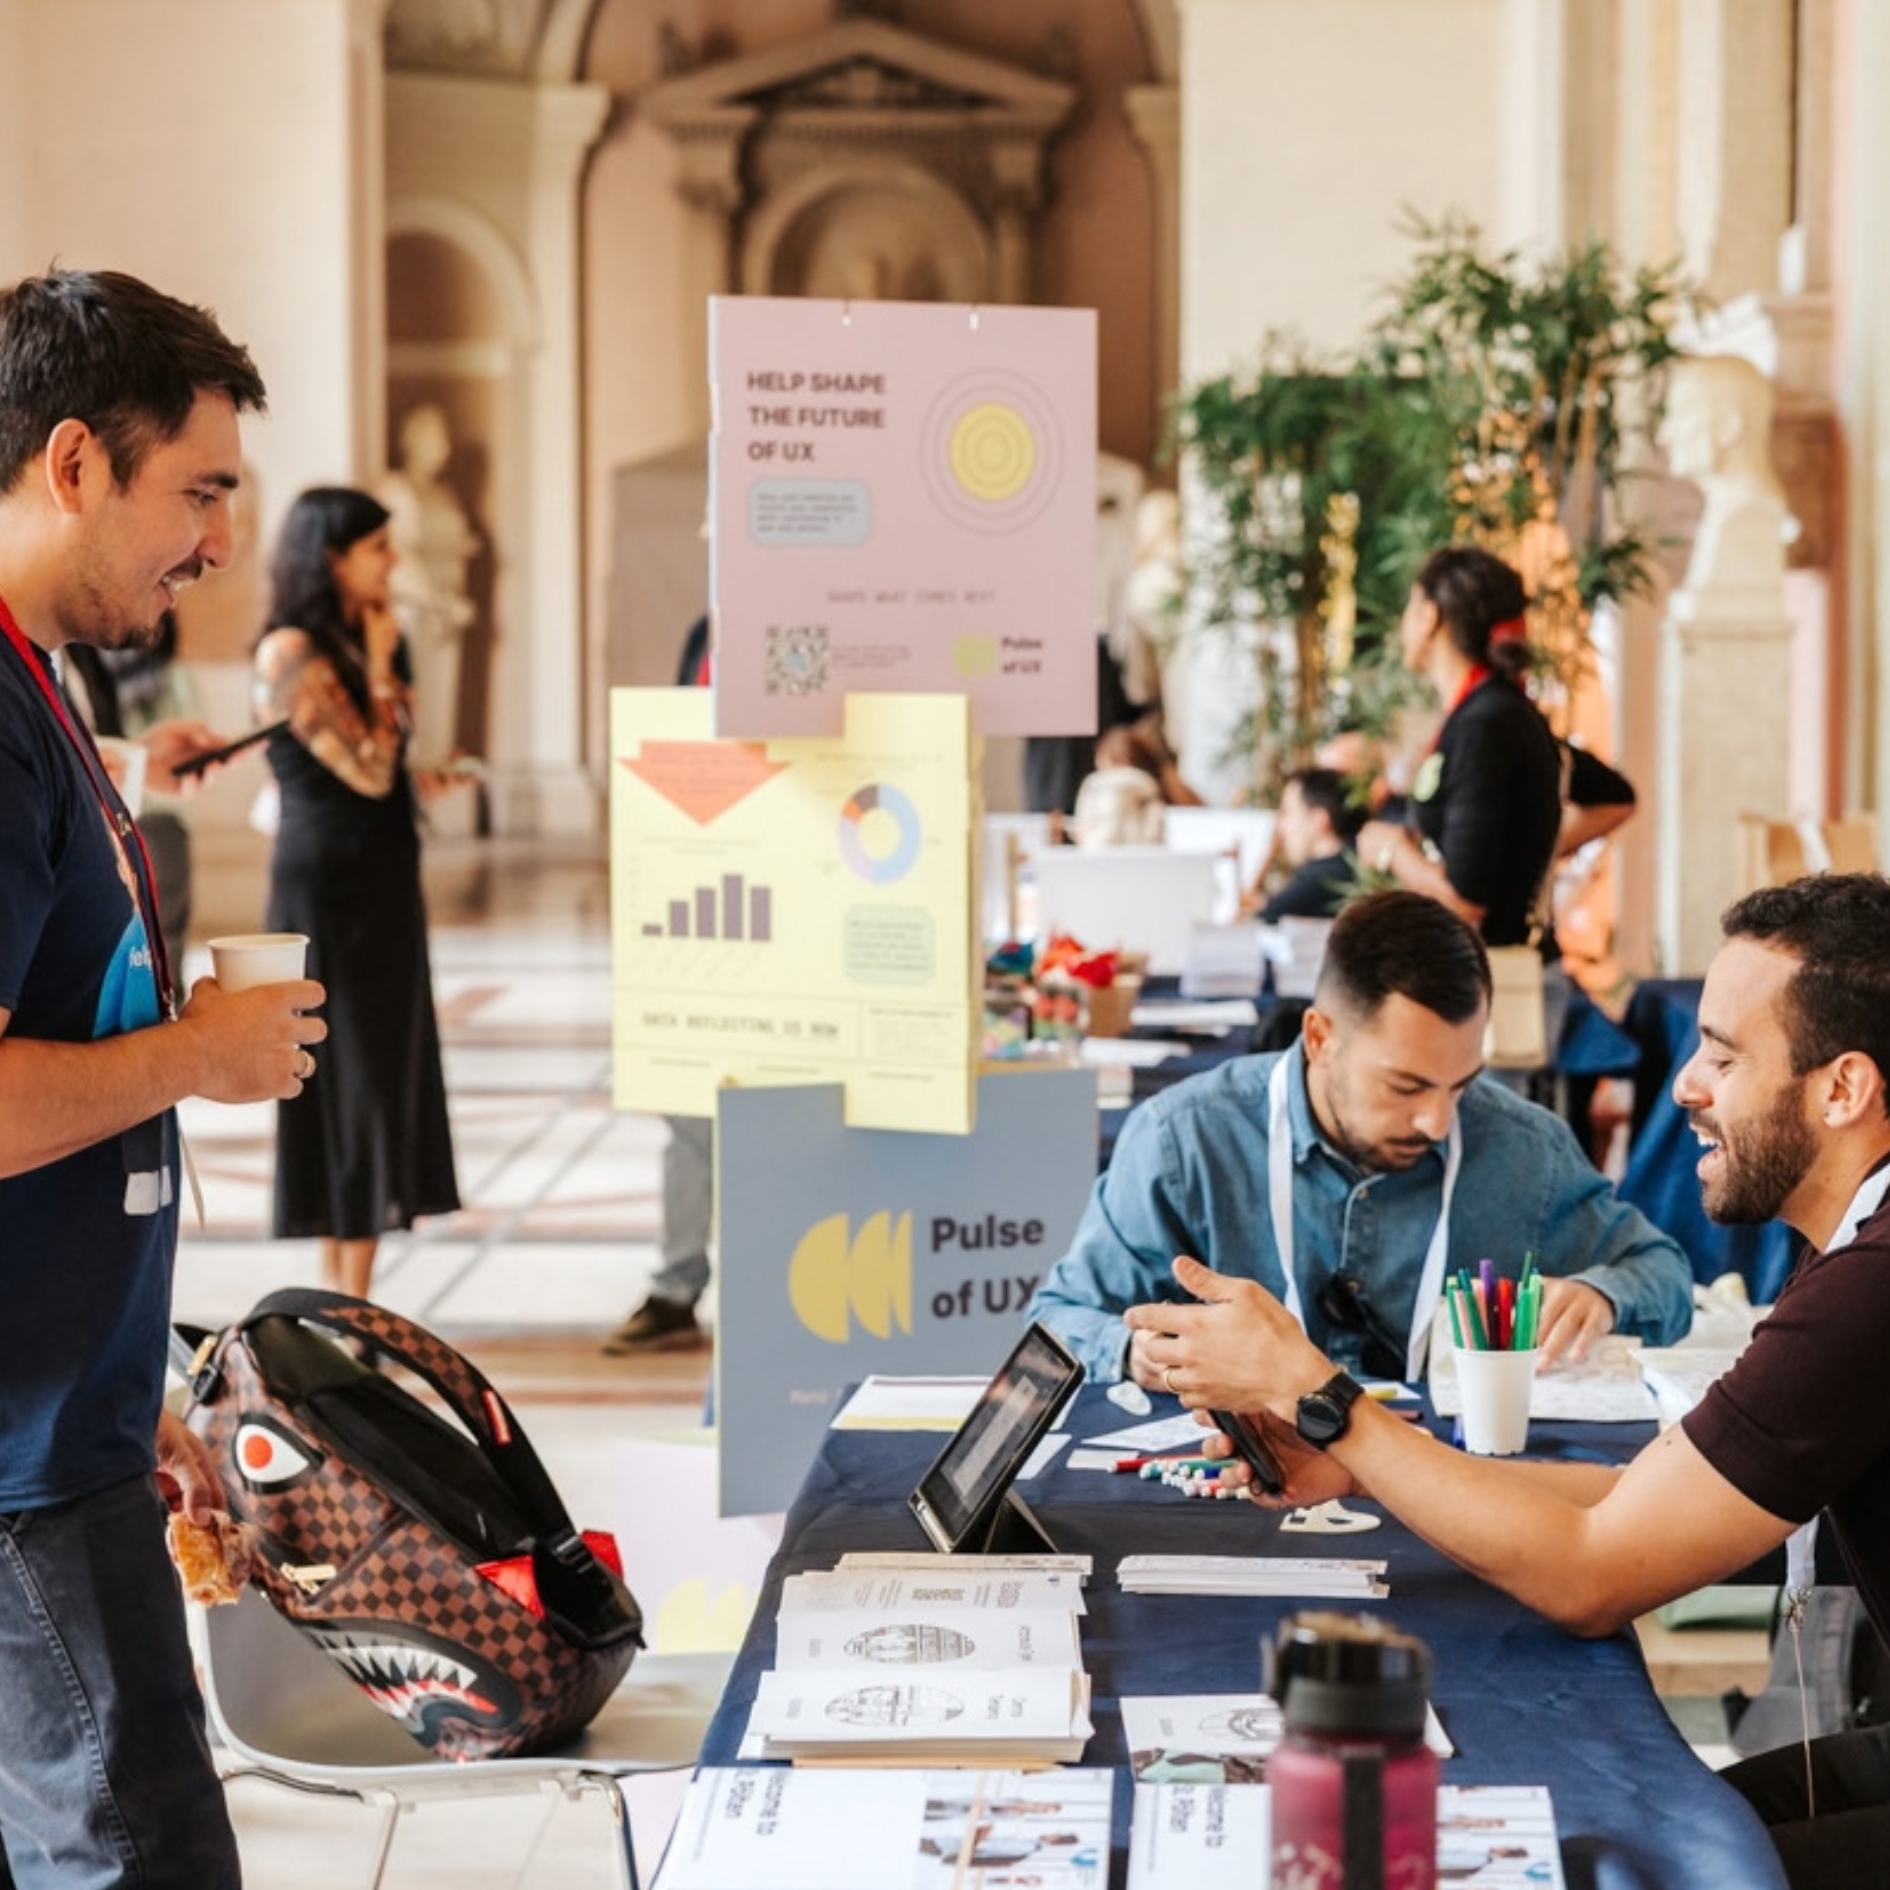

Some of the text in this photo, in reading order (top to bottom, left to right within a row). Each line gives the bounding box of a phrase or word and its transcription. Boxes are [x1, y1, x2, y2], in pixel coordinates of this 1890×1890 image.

[747, 371, 885, 395] HELP SHAPE
[748, 406, 885, 429] THE FUTURE
[747, 441, 816, 462] OF UX
[1002, 636, 1043, 650] Pulse
[1002, 660, 1042, 675] of UX
[931, 1213, 1045, 1254] Pulse
[931, 1275, 1041, 1319] of UX
